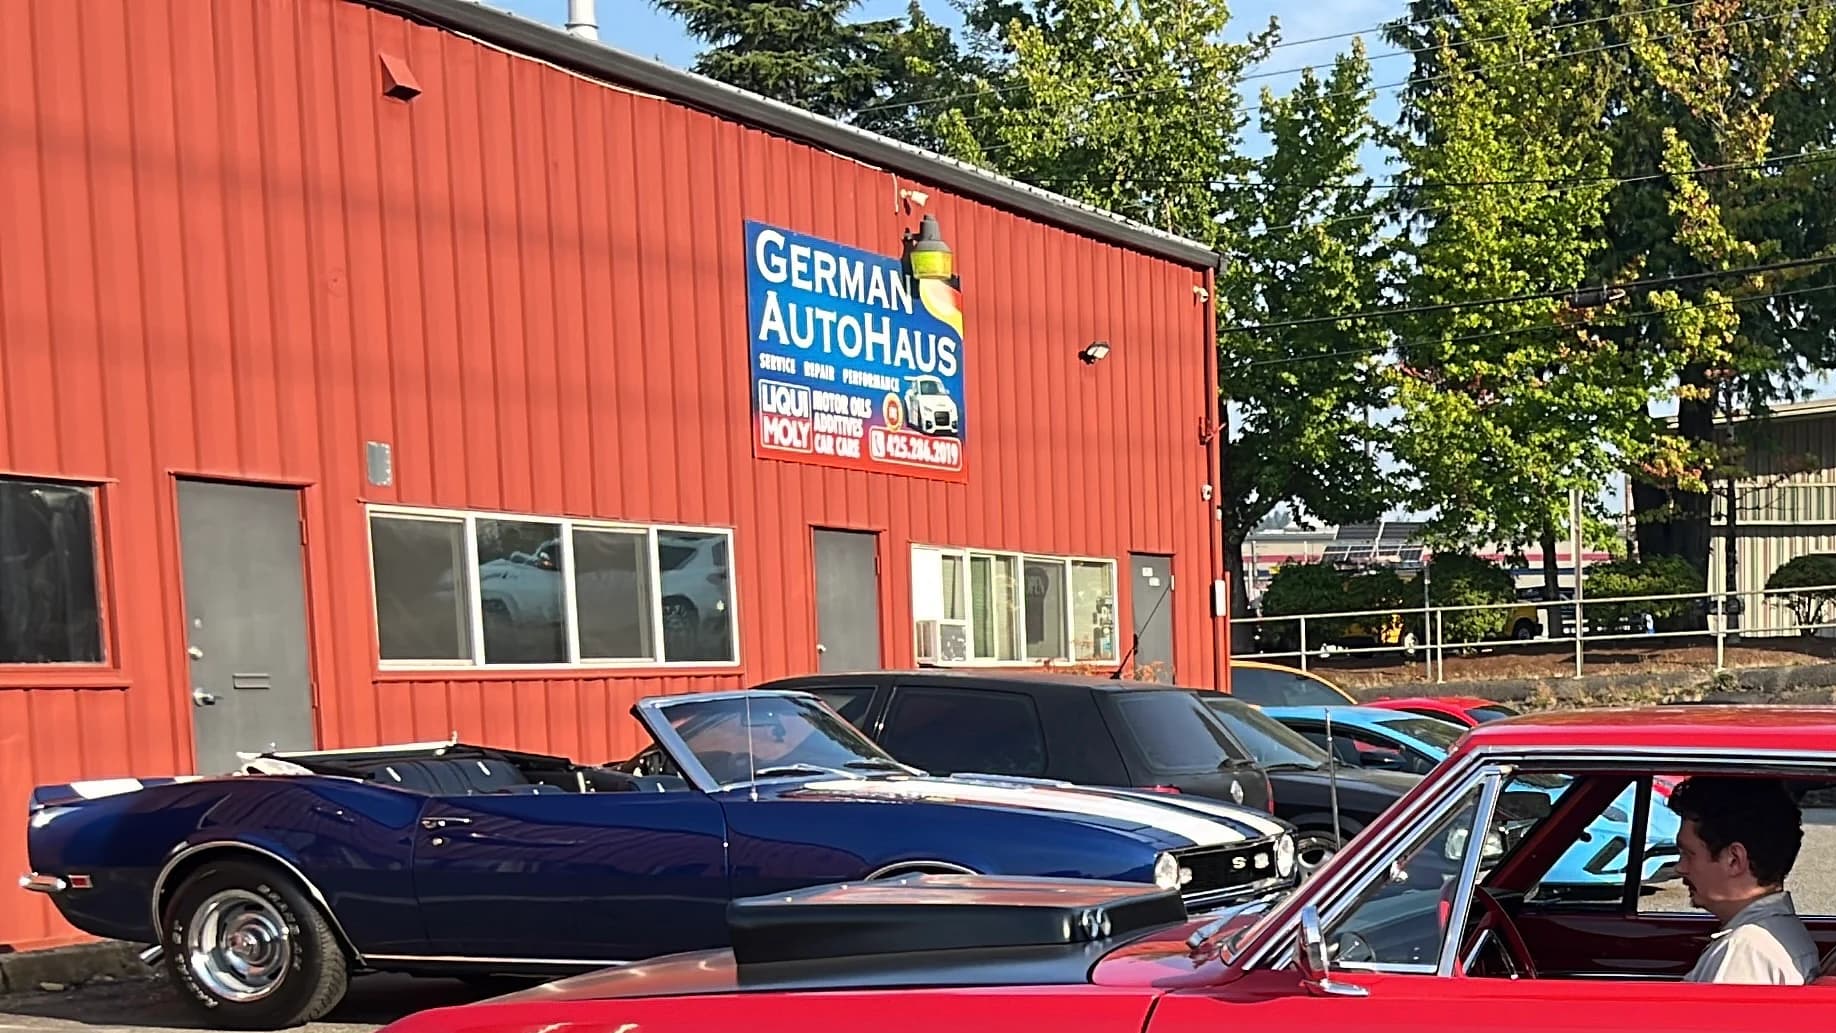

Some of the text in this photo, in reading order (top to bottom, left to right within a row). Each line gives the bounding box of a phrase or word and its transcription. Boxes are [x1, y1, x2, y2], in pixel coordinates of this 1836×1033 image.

[759, 353, 900, 393] SERVICE REPAIR PERFORMANCE
[762, 383, 809, 418] LIQUI
[813, 390, 849, 414] MOTOR
[849, 395, 873, 419] OILS
[763, 415, 811, 449] MOLY
[813, 412, 864, 438] ADDITIVES
[814, 434, 861, 459] CAR CARE
